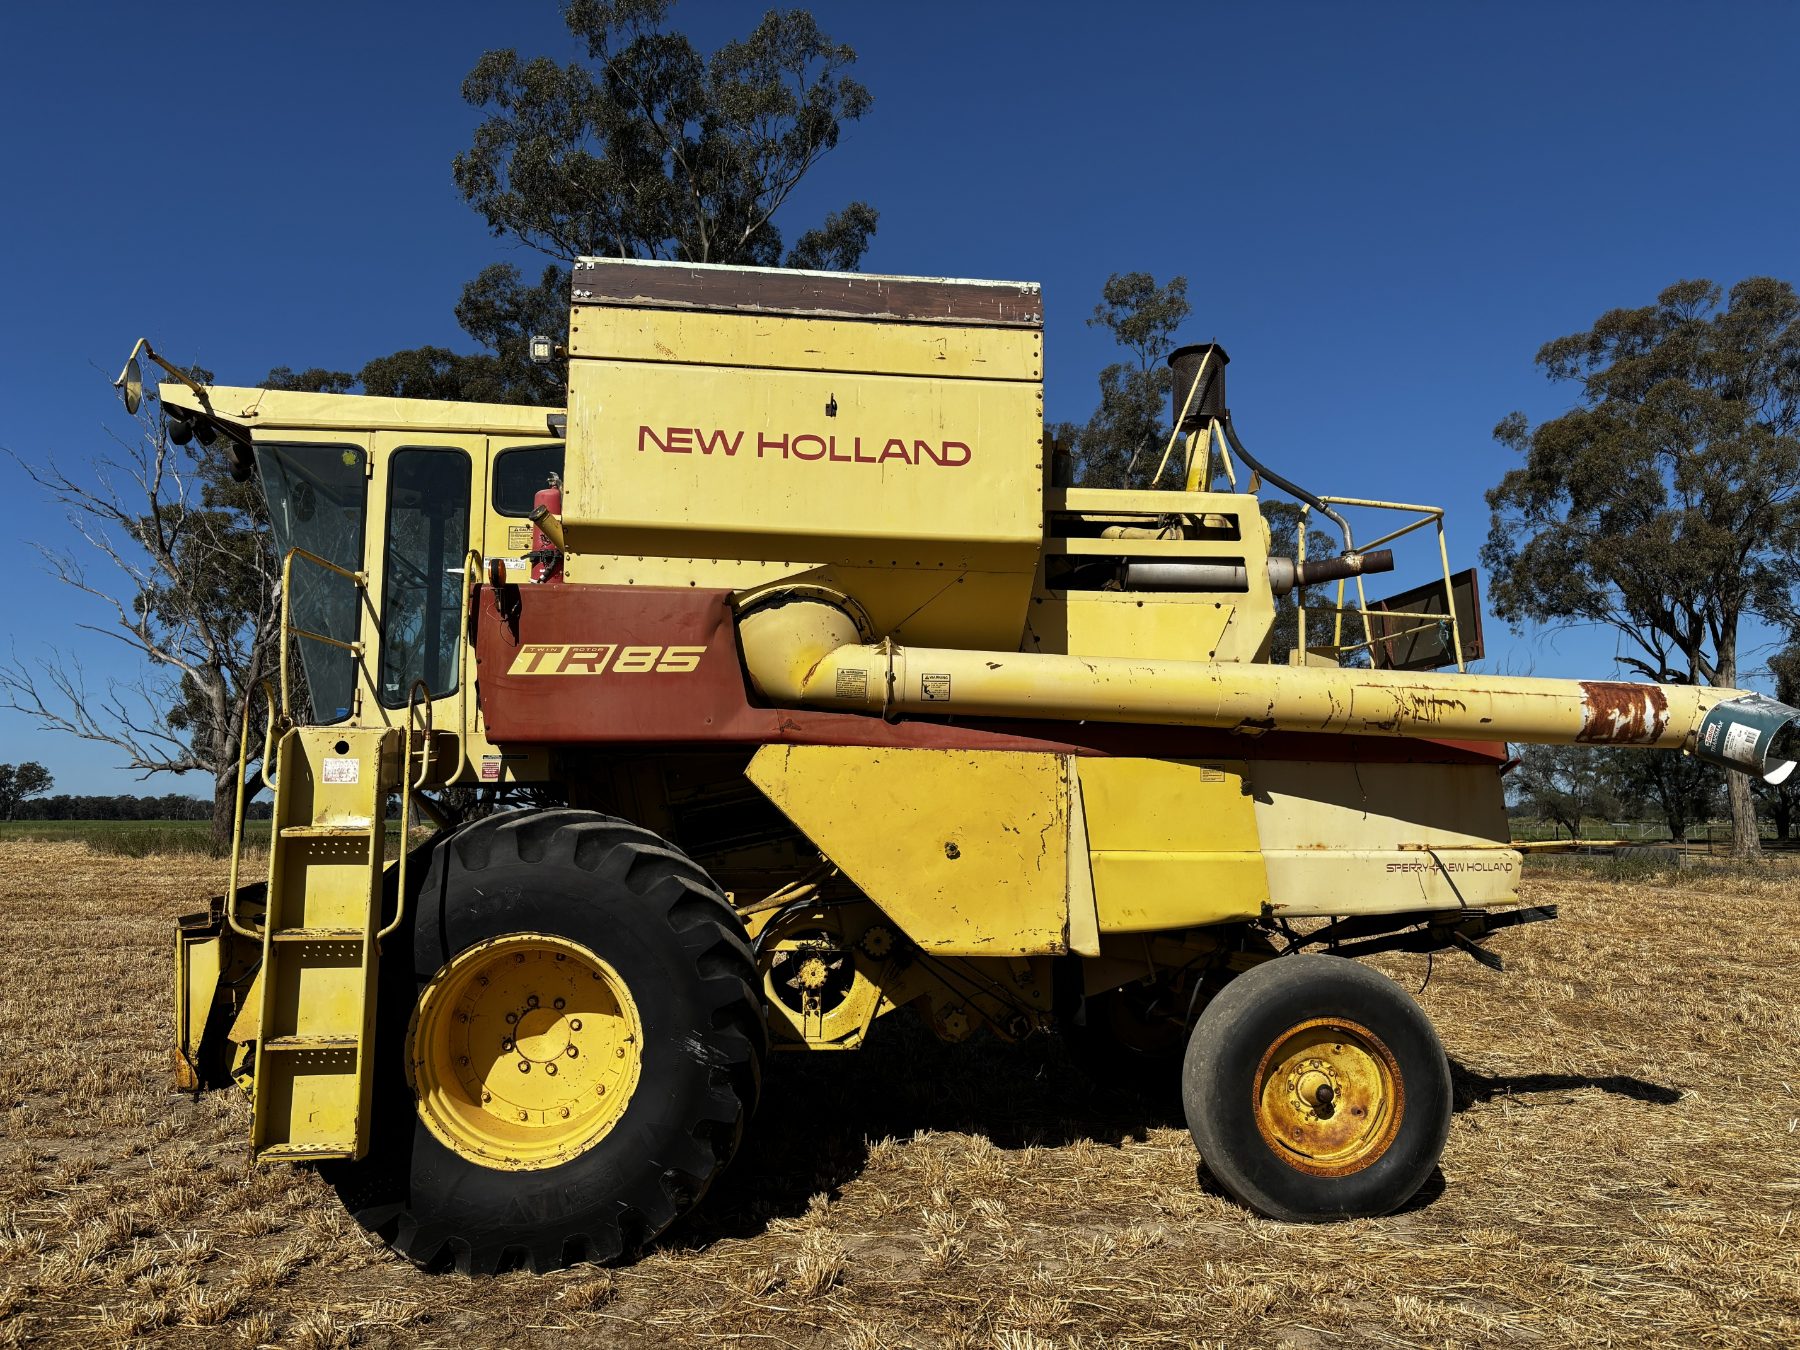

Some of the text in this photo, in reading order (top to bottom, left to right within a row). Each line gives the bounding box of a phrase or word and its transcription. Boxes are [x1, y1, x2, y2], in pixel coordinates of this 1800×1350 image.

[638, 426, 972, 467] NEW HOLLAND
[1386, 863, 1429, 873] SPERRY
[1467, 862, 1513, 873] HOLLAND
